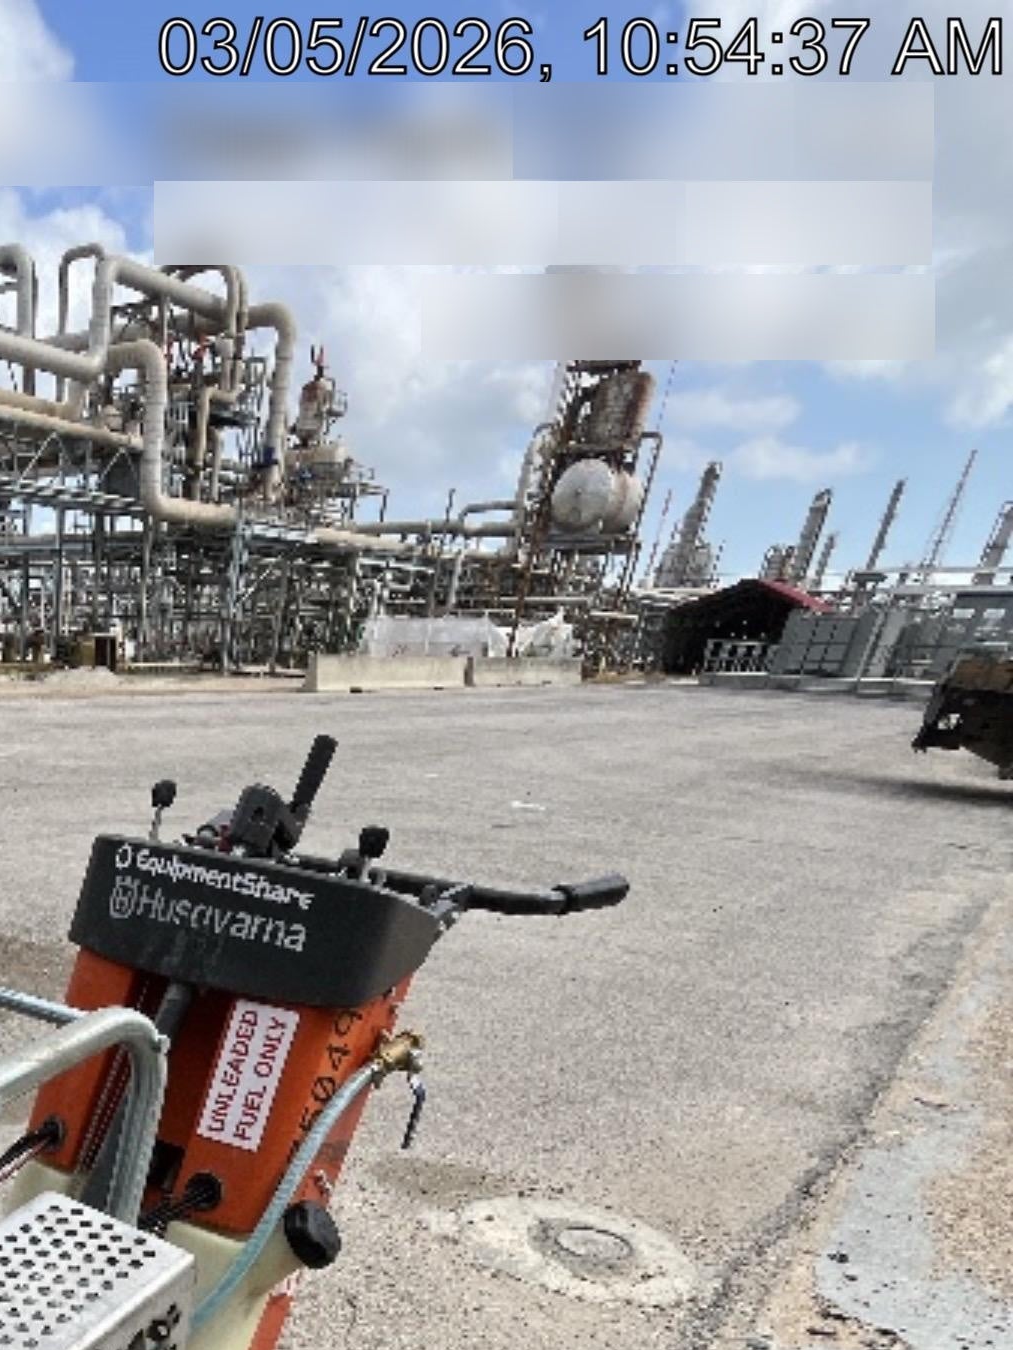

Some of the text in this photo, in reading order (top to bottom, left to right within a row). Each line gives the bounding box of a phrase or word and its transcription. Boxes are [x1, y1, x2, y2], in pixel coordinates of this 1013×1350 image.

[136, 883, 307, 951] Husqvarna
[137, 848, 316, 910] EquipmentShare
[207, 1009, 259, 1133] UNLEADED
[233, 1015, 287, 1141] FUEL ONLY
